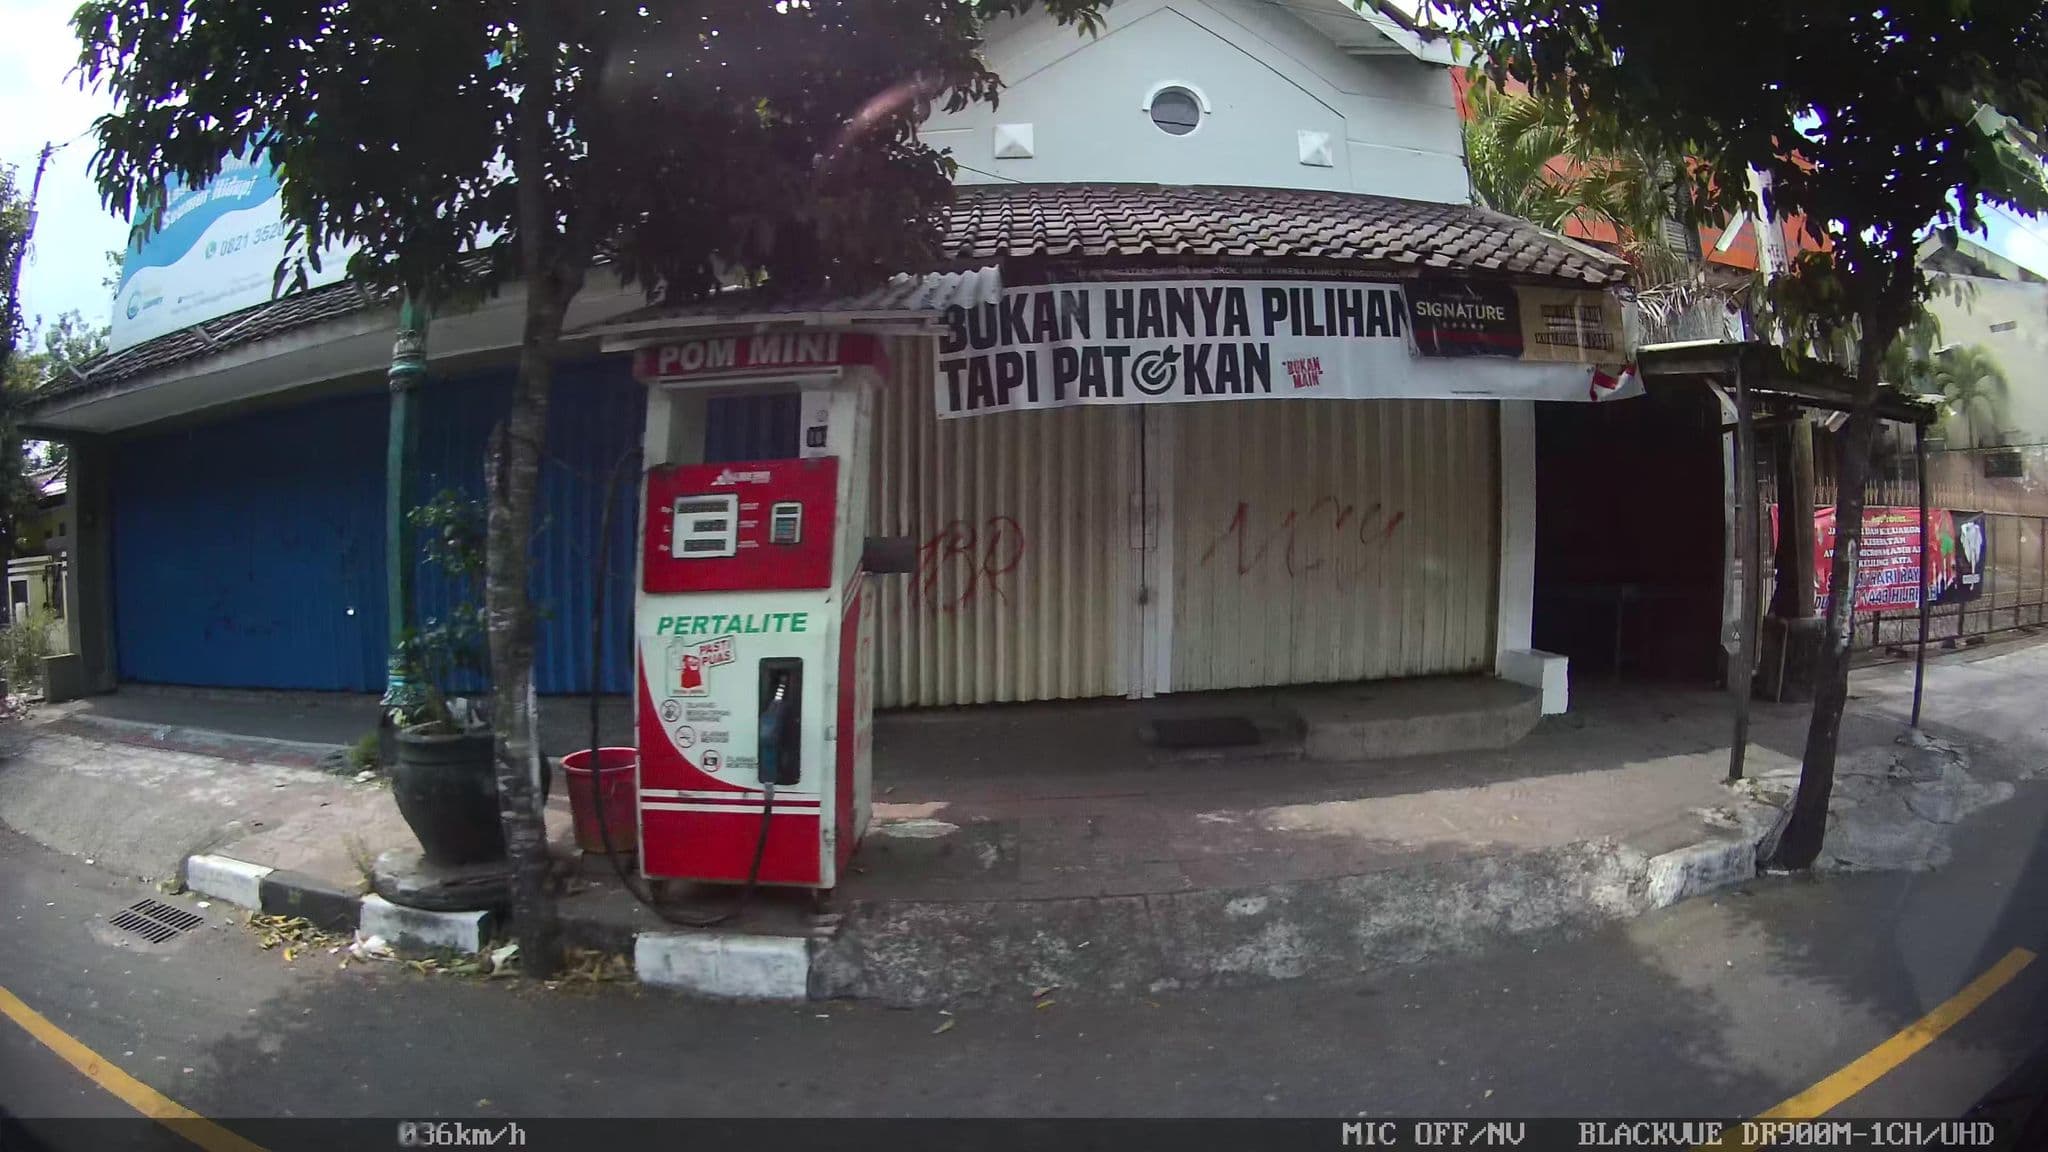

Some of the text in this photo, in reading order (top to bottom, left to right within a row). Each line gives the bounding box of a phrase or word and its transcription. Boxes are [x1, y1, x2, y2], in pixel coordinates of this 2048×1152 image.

[939, 290, 1090, 353] BUKAN
[1105, 287, 1251, 338] HANYA
[1415, 301, 1505, 321] SIGNATURE
[658, 331, 839, 374] POM MINI
[939, 350, 1039, 411] TAPI
[1900, 566, 1920, 582] RAY
[656, 612, 808, 636] PERTALITE
